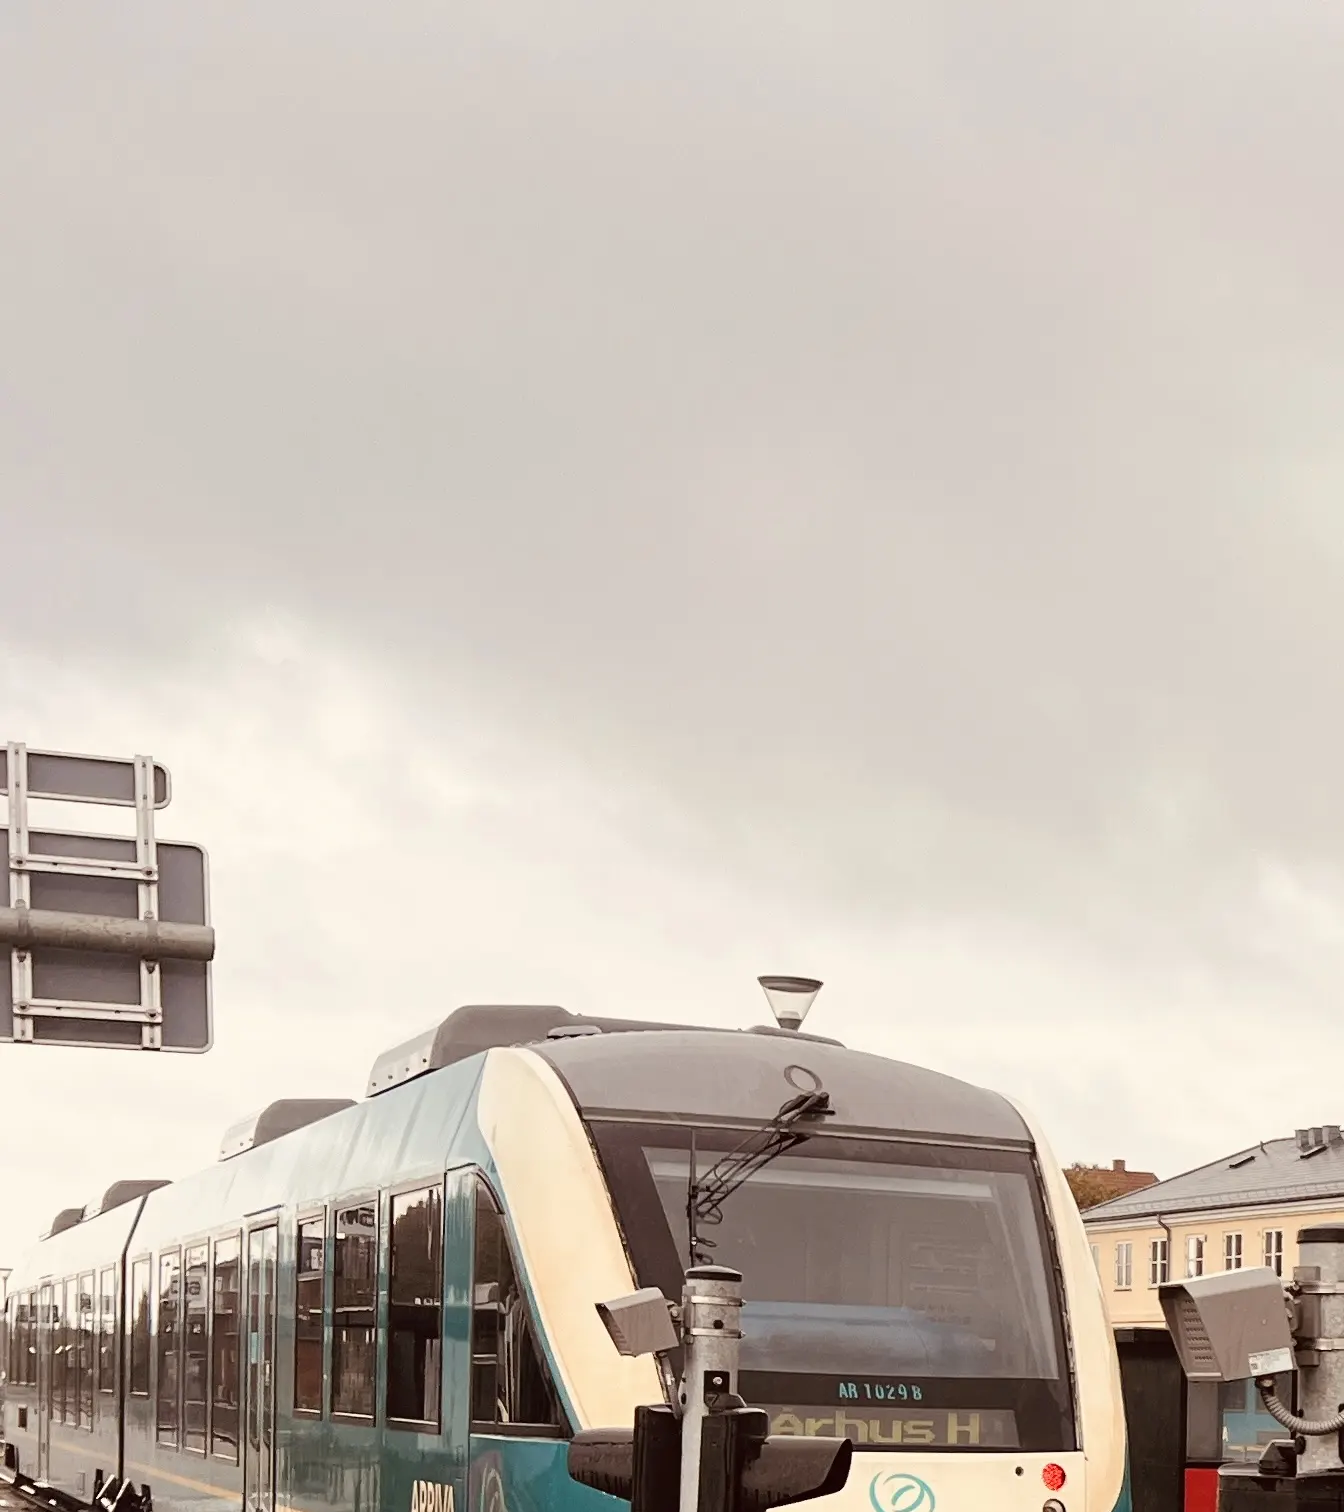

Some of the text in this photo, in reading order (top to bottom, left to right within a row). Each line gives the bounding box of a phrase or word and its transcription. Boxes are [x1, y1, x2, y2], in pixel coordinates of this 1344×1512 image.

[839, 1382, 858, 1398] AR
[769, 1408, 981, 1445] Århus H
